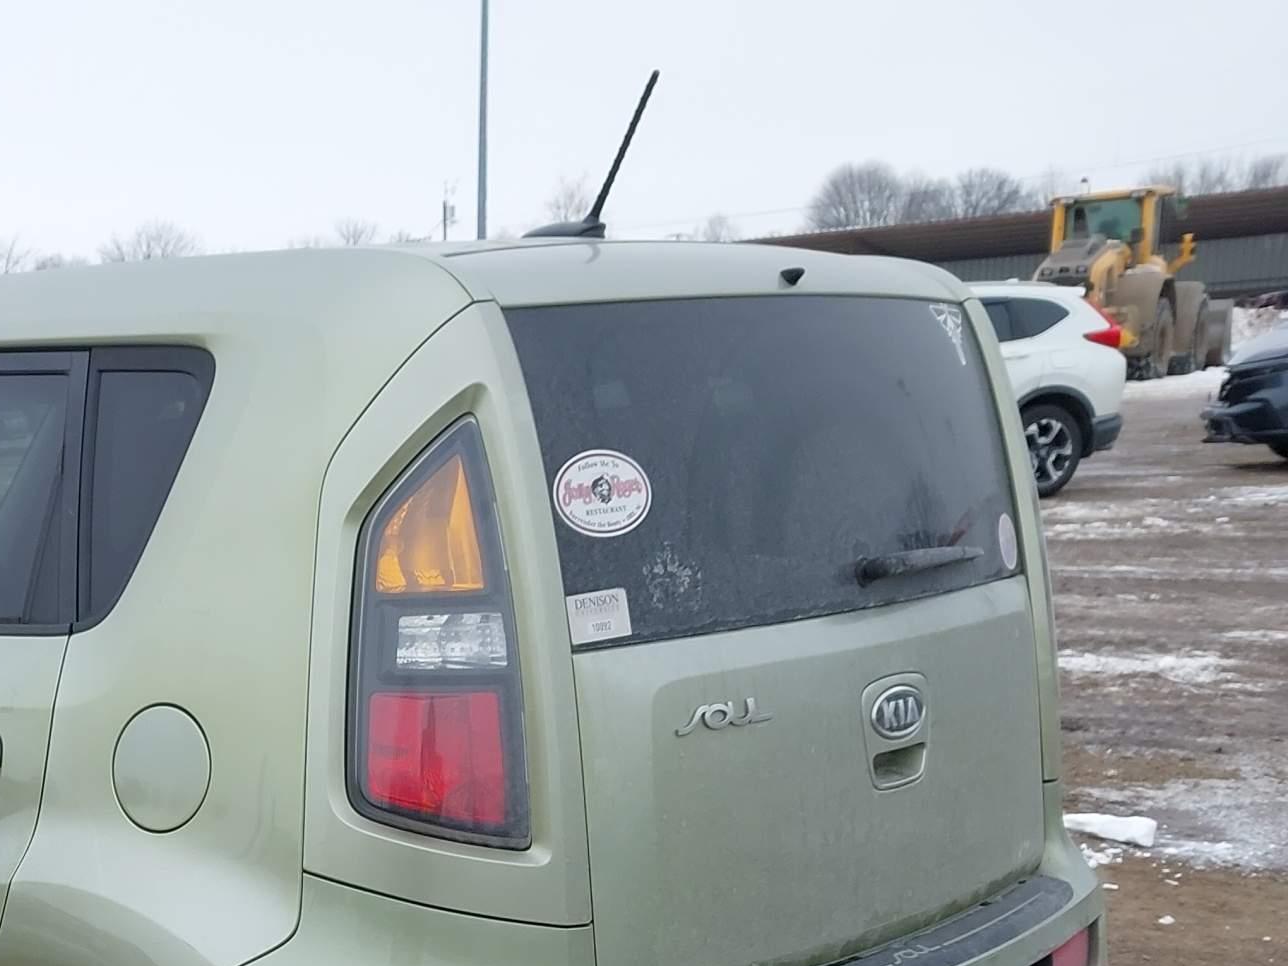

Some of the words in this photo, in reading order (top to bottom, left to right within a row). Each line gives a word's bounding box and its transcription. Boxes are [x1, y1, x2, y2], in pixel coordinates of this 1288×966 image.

[585, 505, 627, 516] RESTAURANT
[574, 593, 620, 610] DENISON
[880, 696, 920, 730] KIA
